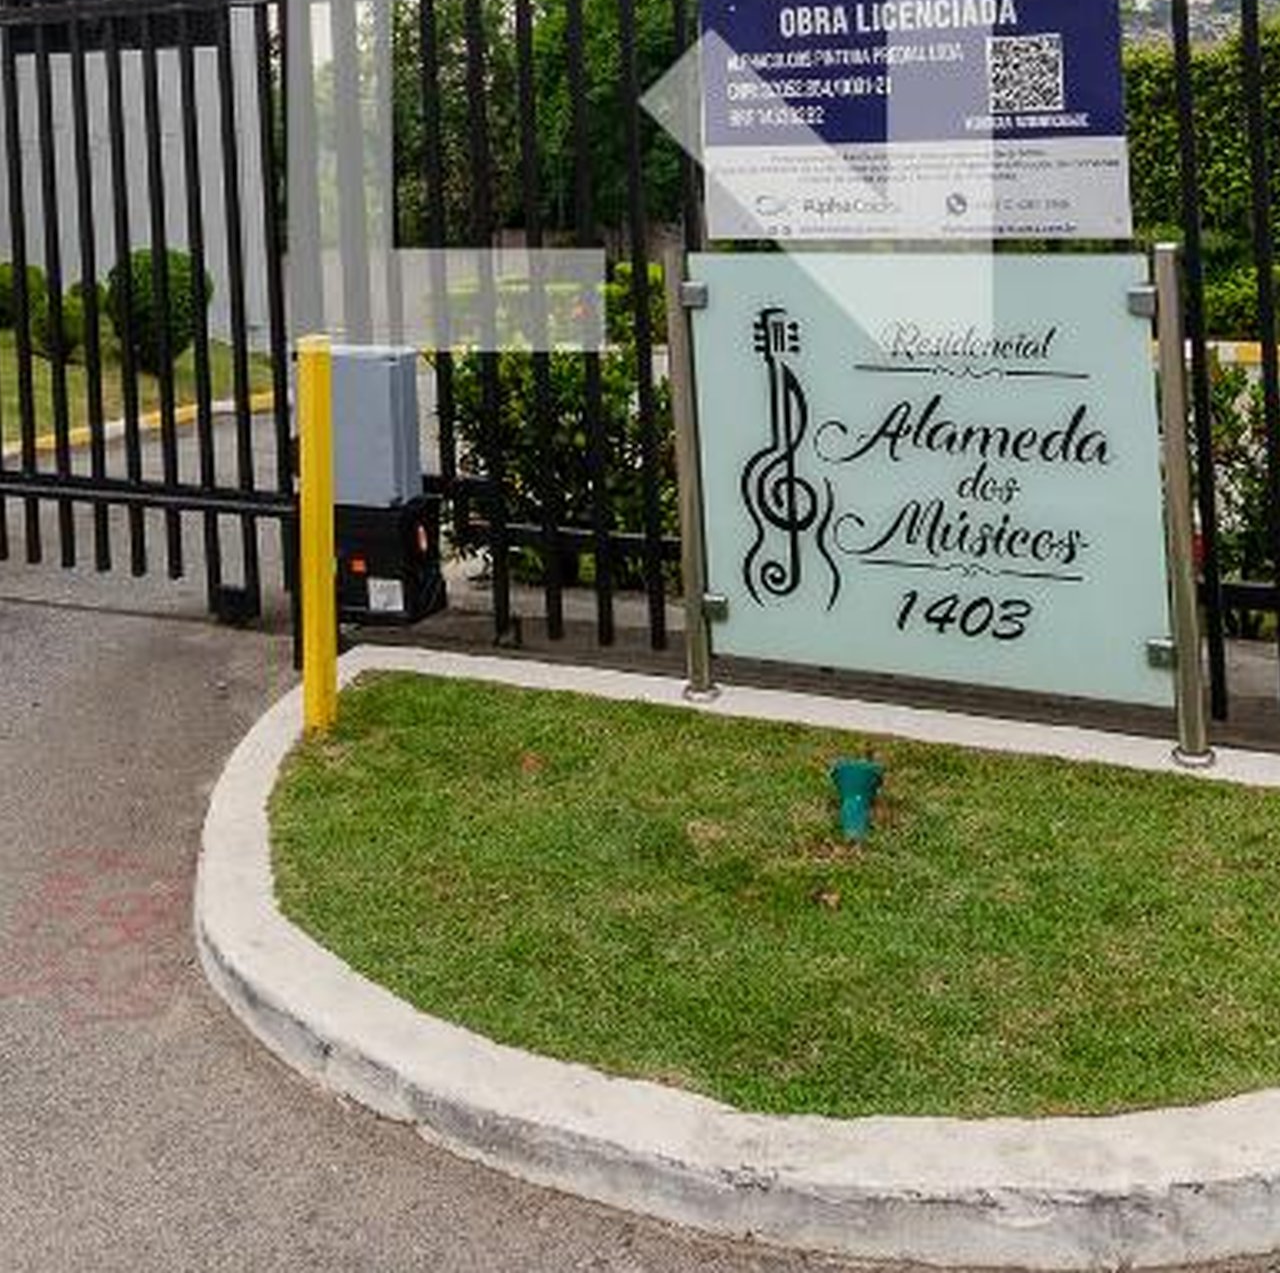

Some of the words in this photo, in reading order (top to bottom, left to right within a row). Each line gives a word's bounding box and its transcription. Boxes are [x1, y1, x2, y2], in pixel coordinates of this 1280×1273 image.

[780, 5, 848, 37] OBRA
[889, 323, 1057, 361] Residencial
[814, 394, 1110, 465] Alameda
[957, 463, 1020, 504] dos
[834, 500, 1090, 564] Músicos
[895, 589, 1033, 641] 1403
